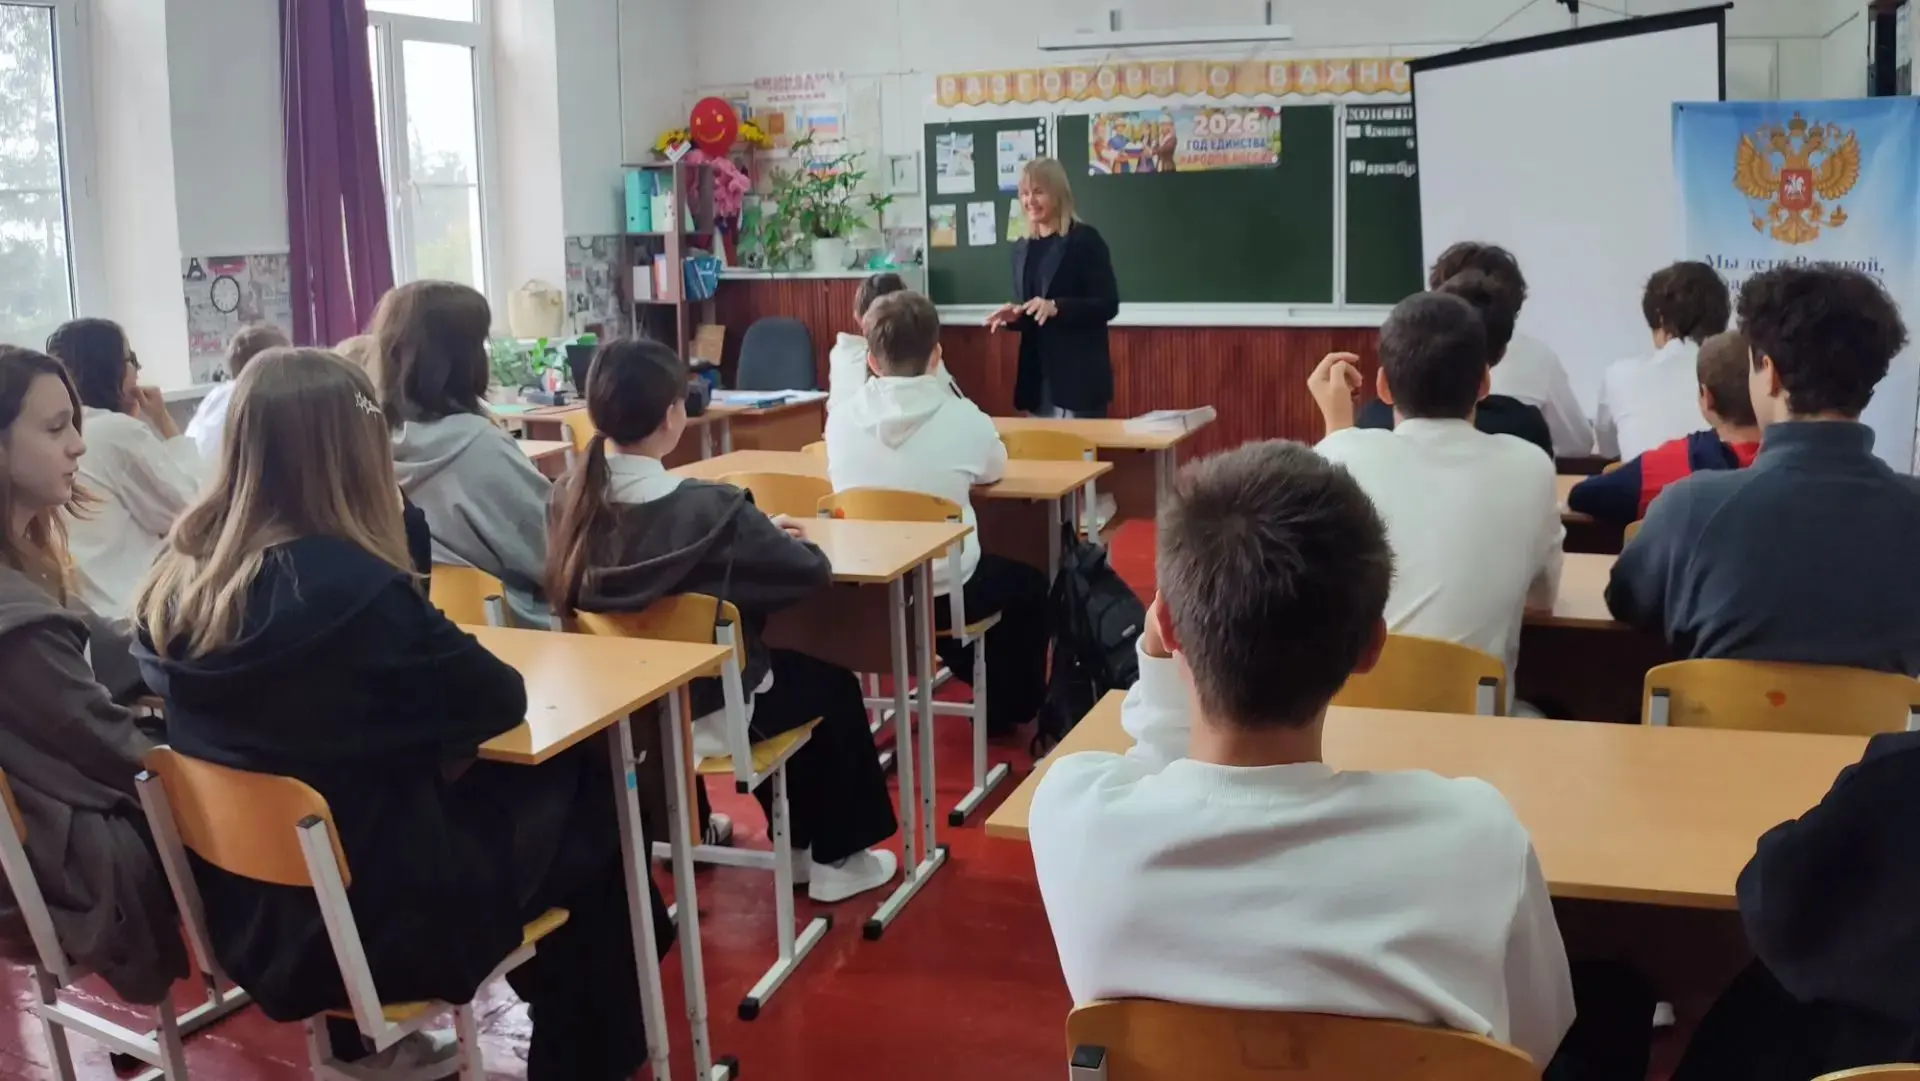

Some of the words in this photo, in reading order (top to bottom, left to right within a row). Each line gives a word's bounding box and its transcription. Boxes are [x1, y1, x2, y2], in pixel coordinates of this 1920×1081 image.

[941, 65, 1175, 99] РАЗГОВОРЫ
[1193, 112, 1261, 136] 2026
[1187, 140, 1208, 151] ГОД
[1211, 137, 1265, 150] ЕДИНСТВА
[1706, 254, 1739, 270] Мы
